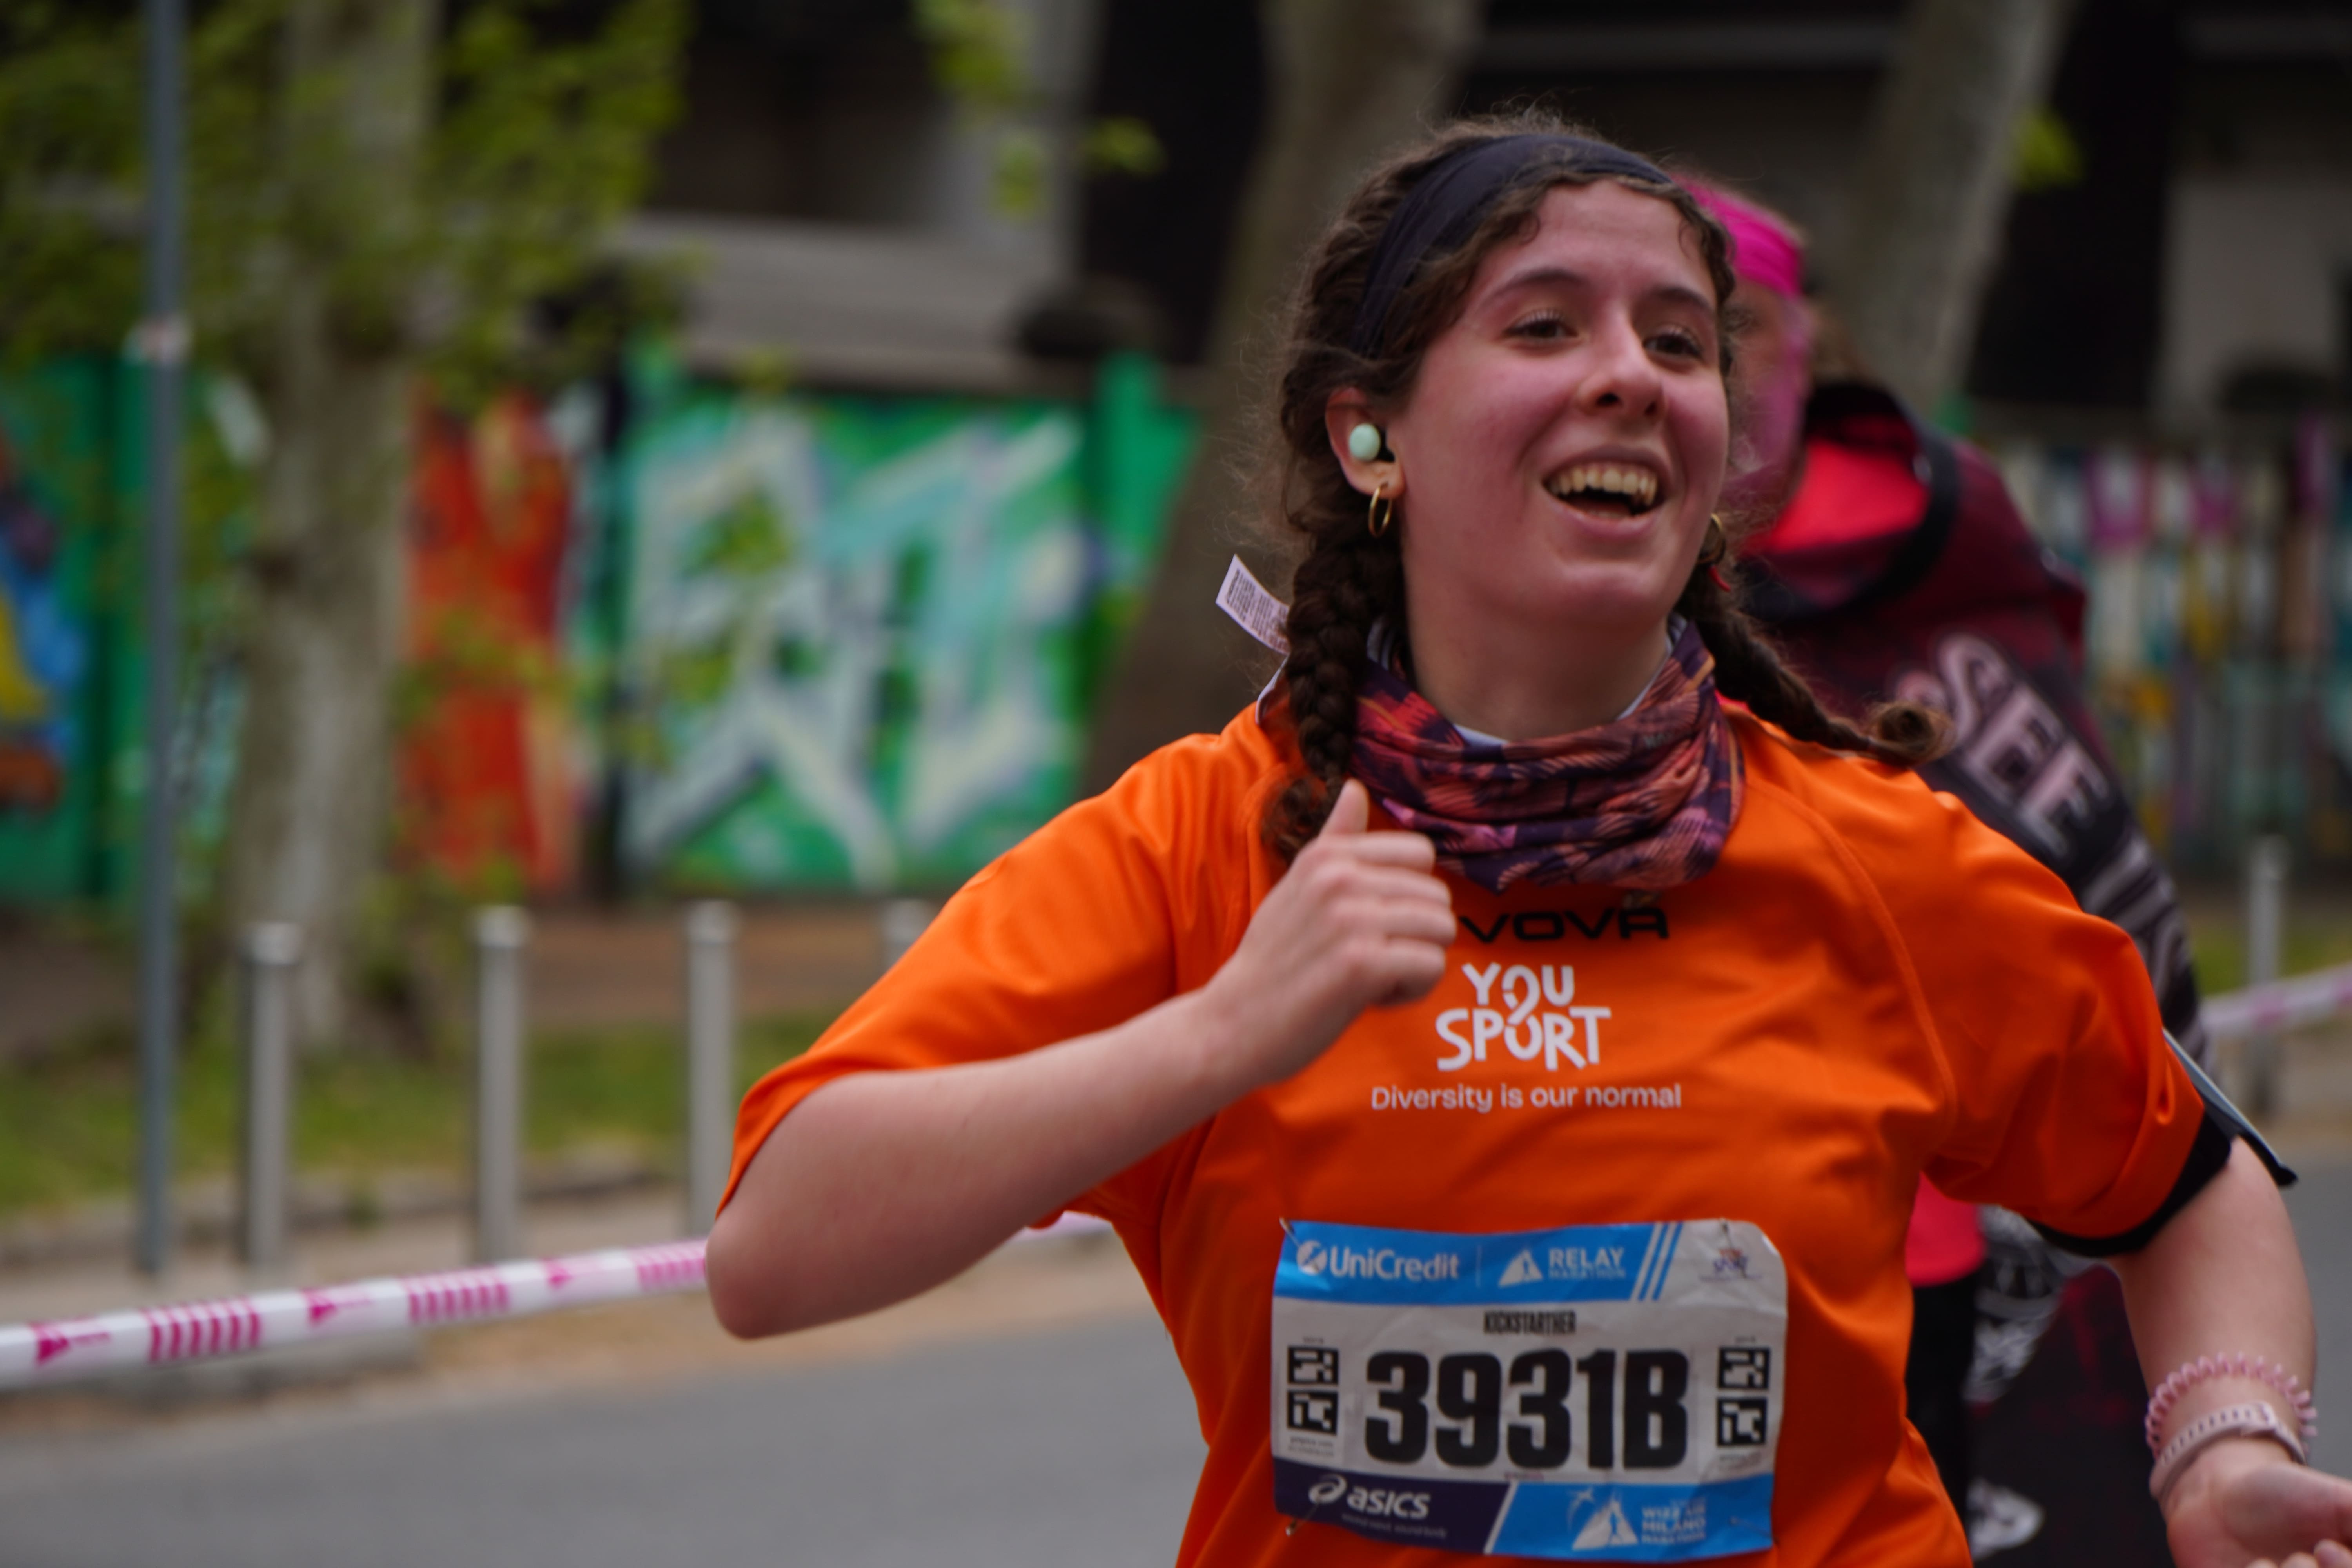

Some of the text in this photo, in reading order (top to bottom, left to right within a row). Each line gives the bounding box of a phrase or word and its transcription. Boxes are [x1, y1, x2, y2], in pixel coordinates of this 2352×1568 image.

[1459, 907, 1670, 944] VOVA
[1461, 961, 1575, 1007] YOU
[1435, 1006, 1612, 1071] SPORT
[1371, 1083, 1682, 1114] Diversity is our normal
[1330, 1245, 1460, 1282] UniCredit
[1548, 1247, 1625, 1269] RELAY
[1364, 1348, 1689, 1470] 3931B
